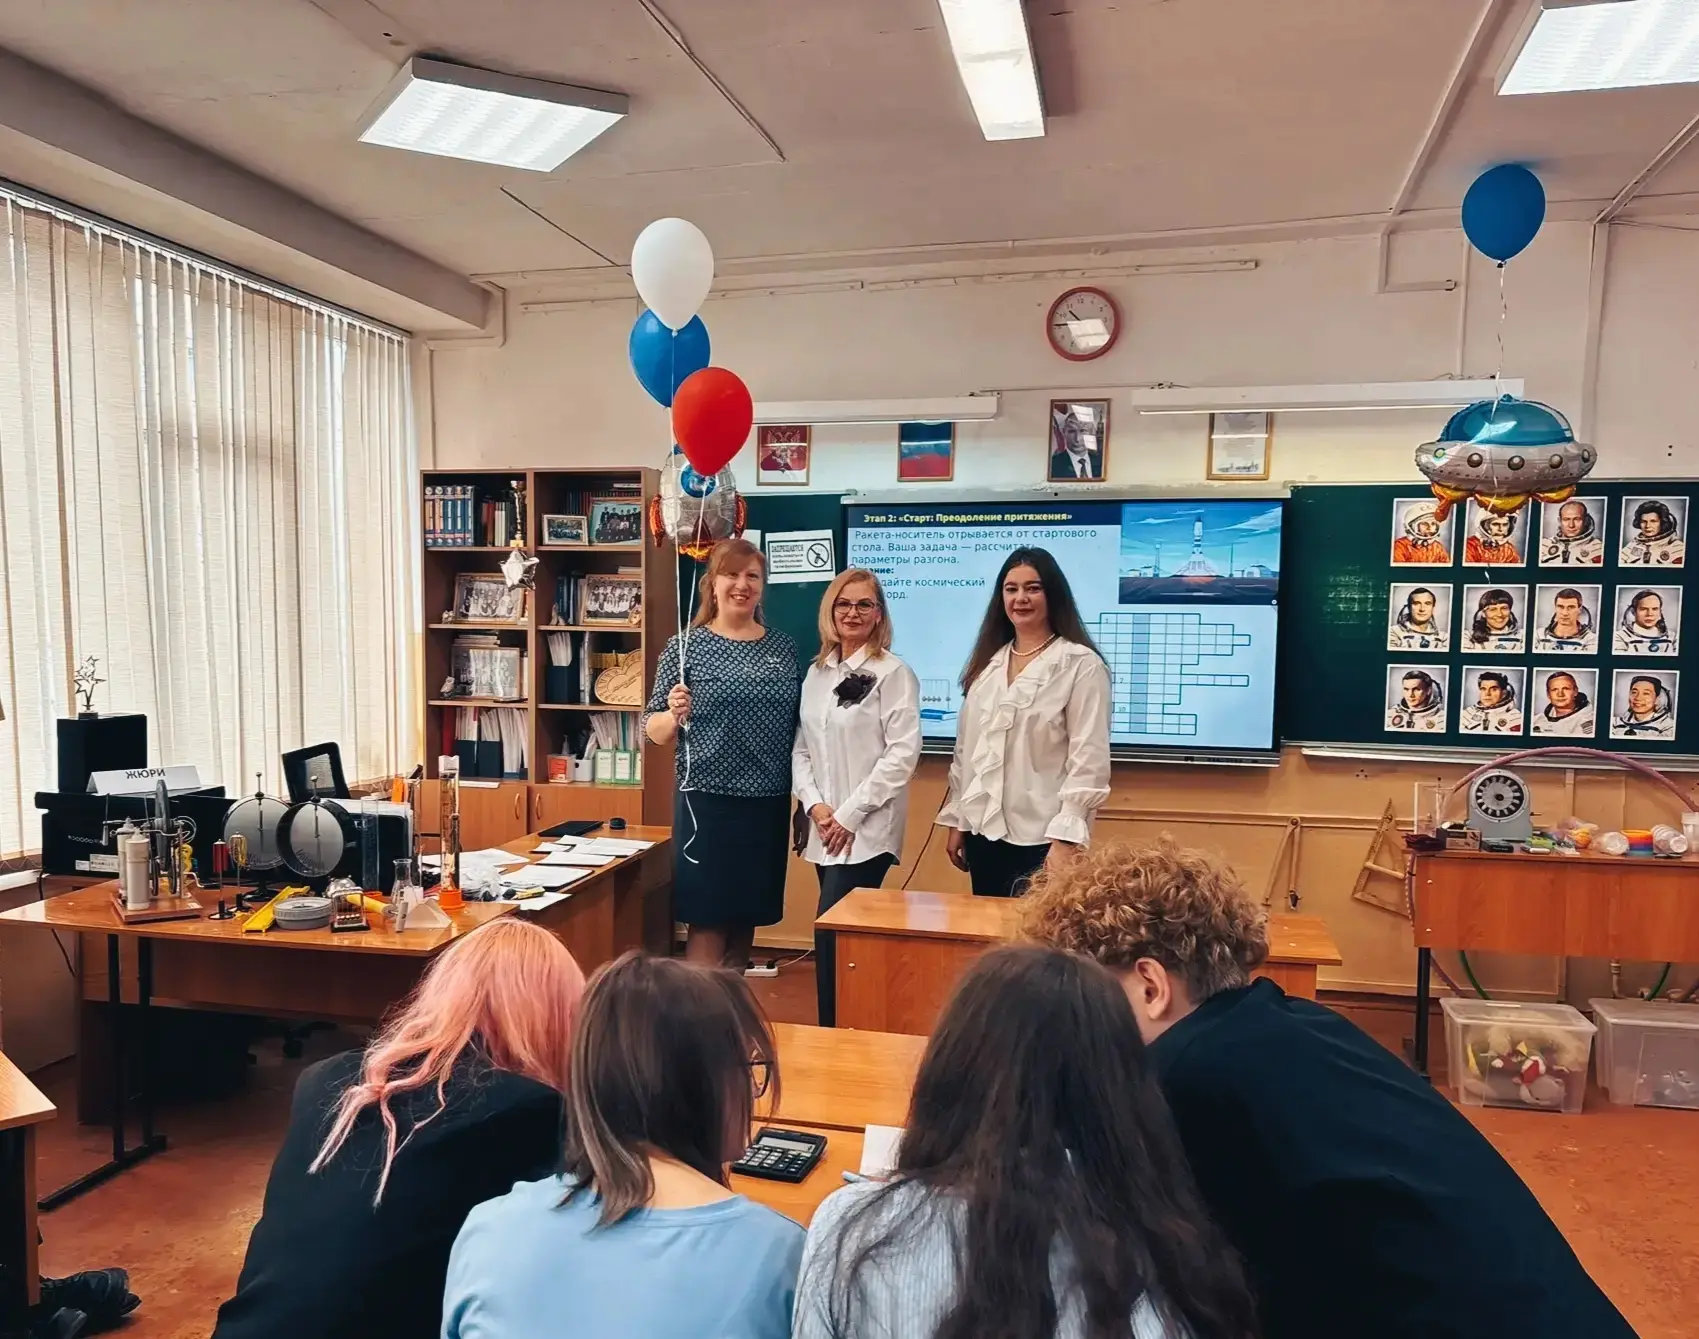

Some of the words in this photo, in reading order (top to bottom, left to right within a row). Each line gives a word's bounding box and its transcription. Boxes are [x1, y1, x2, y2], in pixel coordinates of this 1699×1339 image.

[864, 514, 886, 523] Этап
[888, 514, 897, 522] 2:
[898, 514, 934, 523] «Старт:
[936, 513, 1002, 523] Преодоление
[1004, 513, 1073, 522] притяжения»
[855, 531, 945, 539] Ракета-носитель
[948, 530, 1012, 540] отрывается
[1032, 529, 1097, 539] стартового
[888, 543, 916, 551] Ваша
[920, 544, 958, 552] задача
[852, 556, 910, 565] параметры
[914, 556, 960, 565] разгона.
[915, 578, 985, 587] космический
[125, 768, 166, 779] ЖЮРИ
